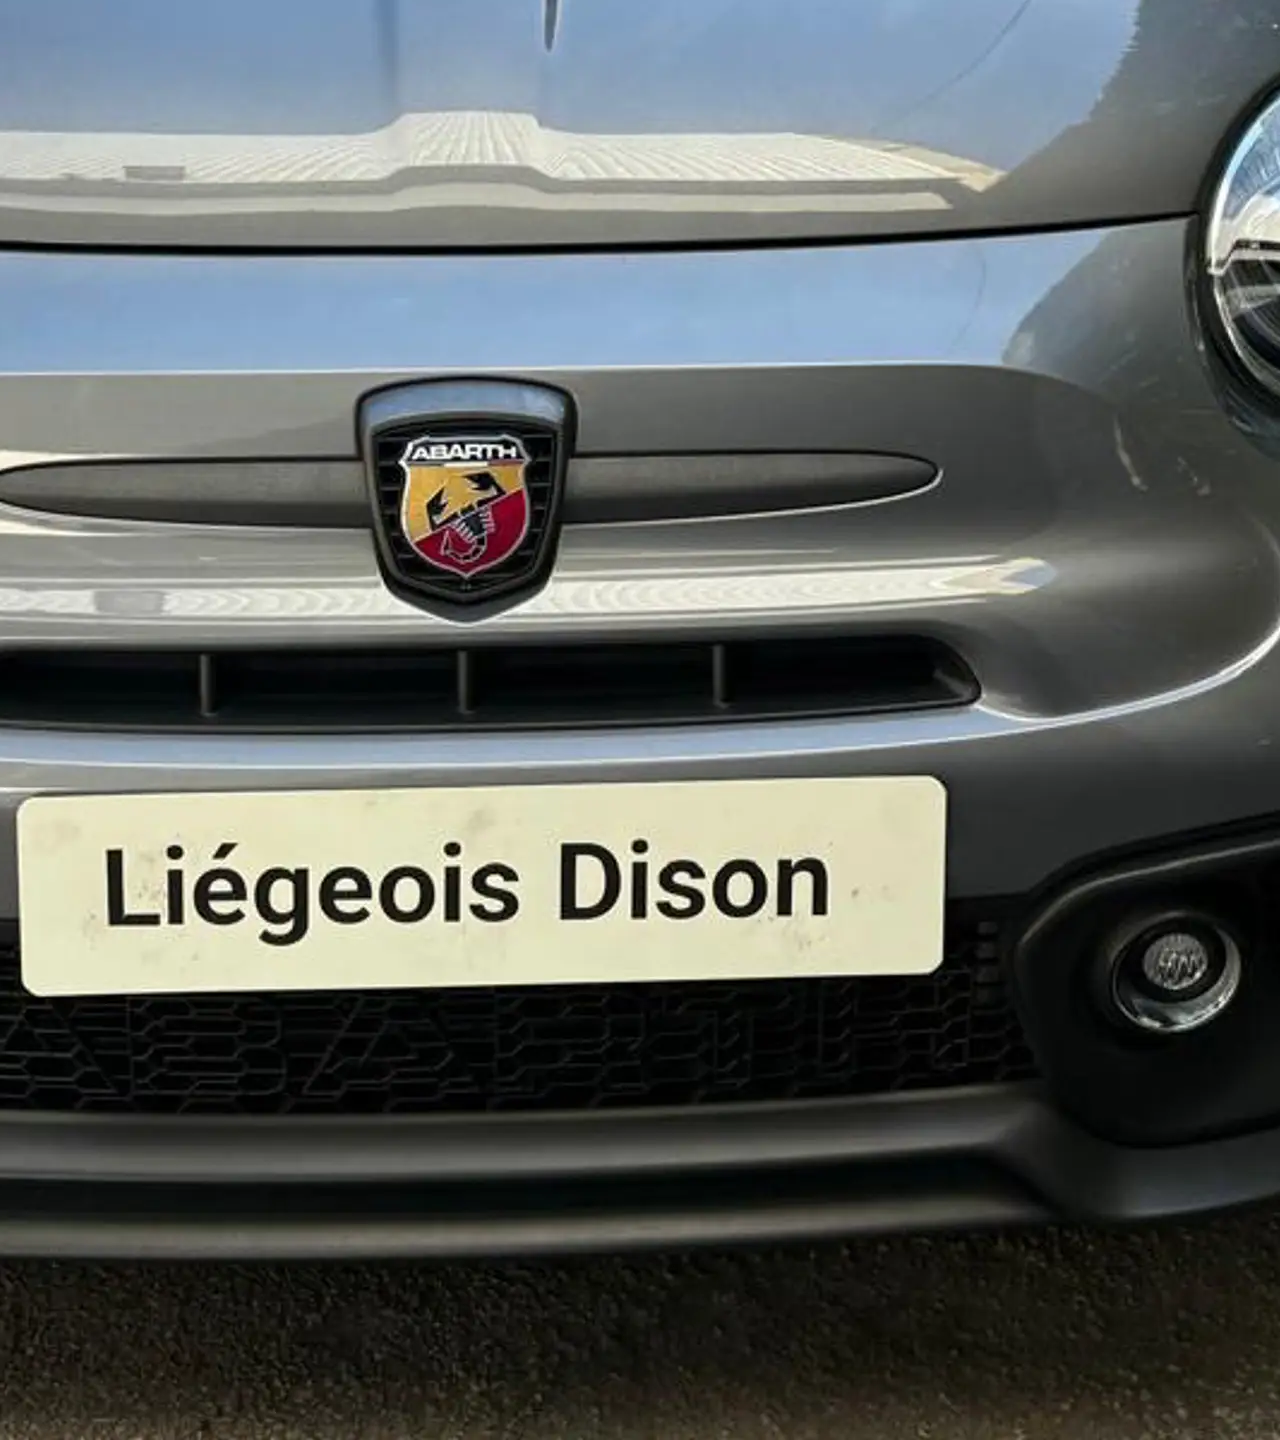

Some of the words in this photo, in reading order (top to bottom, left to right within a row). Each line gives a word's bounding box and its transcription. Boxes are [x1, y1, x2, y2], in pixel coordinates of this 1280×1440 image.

[411, 443, 517, 460] ABARTH
[106, 842, 519, 946] Liégeois
[560, 839, 828, 921] Dison
